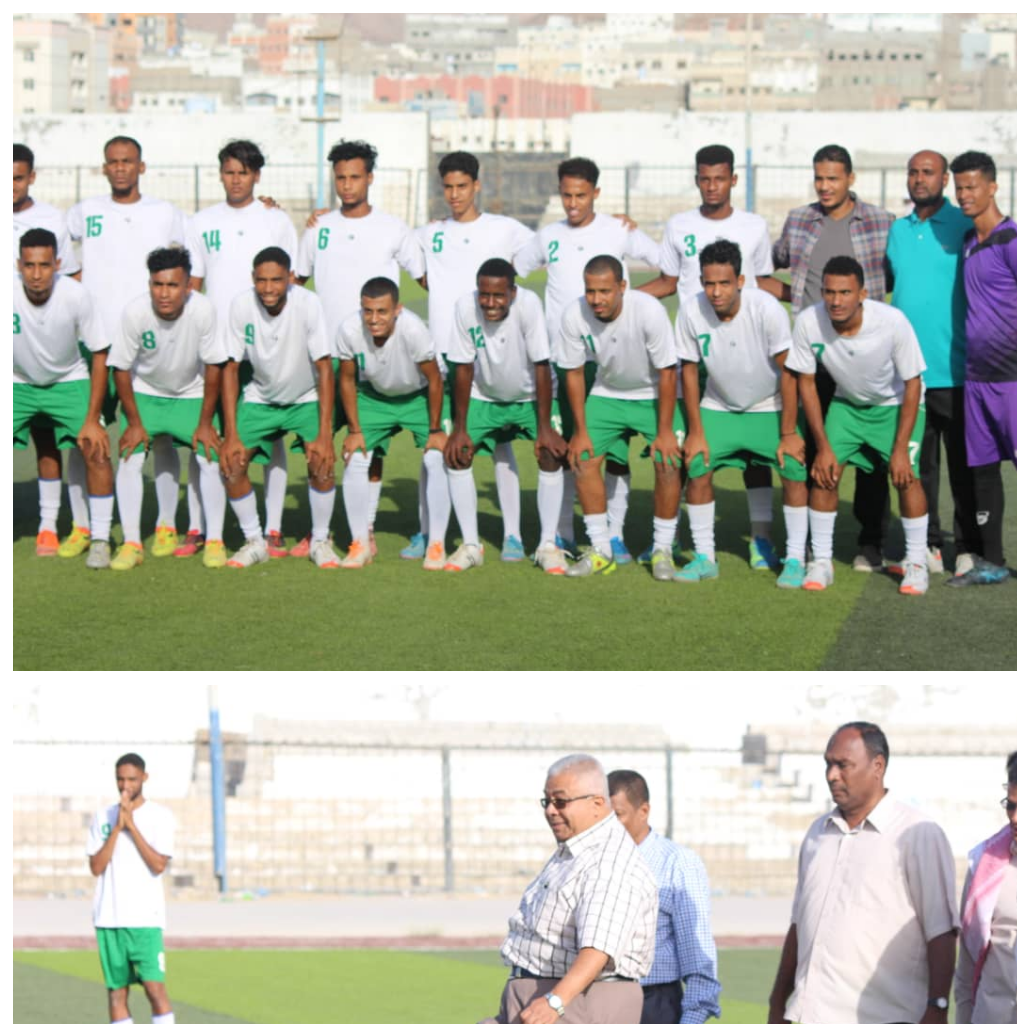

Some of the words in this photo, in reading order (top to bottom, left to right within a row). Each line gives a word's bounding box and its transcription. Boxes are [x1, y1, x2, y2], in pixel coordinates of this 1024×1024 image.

[86, 215, 103, 237] 15
[203, 230, 221, 252] 14
[318, 228, 330, 250] 6
[432, 231, 444, 253] 5
[684, 234, 697, 257] 3
[548, 240, 559, 263] 2
[141, 331, 156, 349] 8
[245, 323, 255, 345] 9
[468, 325, 486, 349] 12
